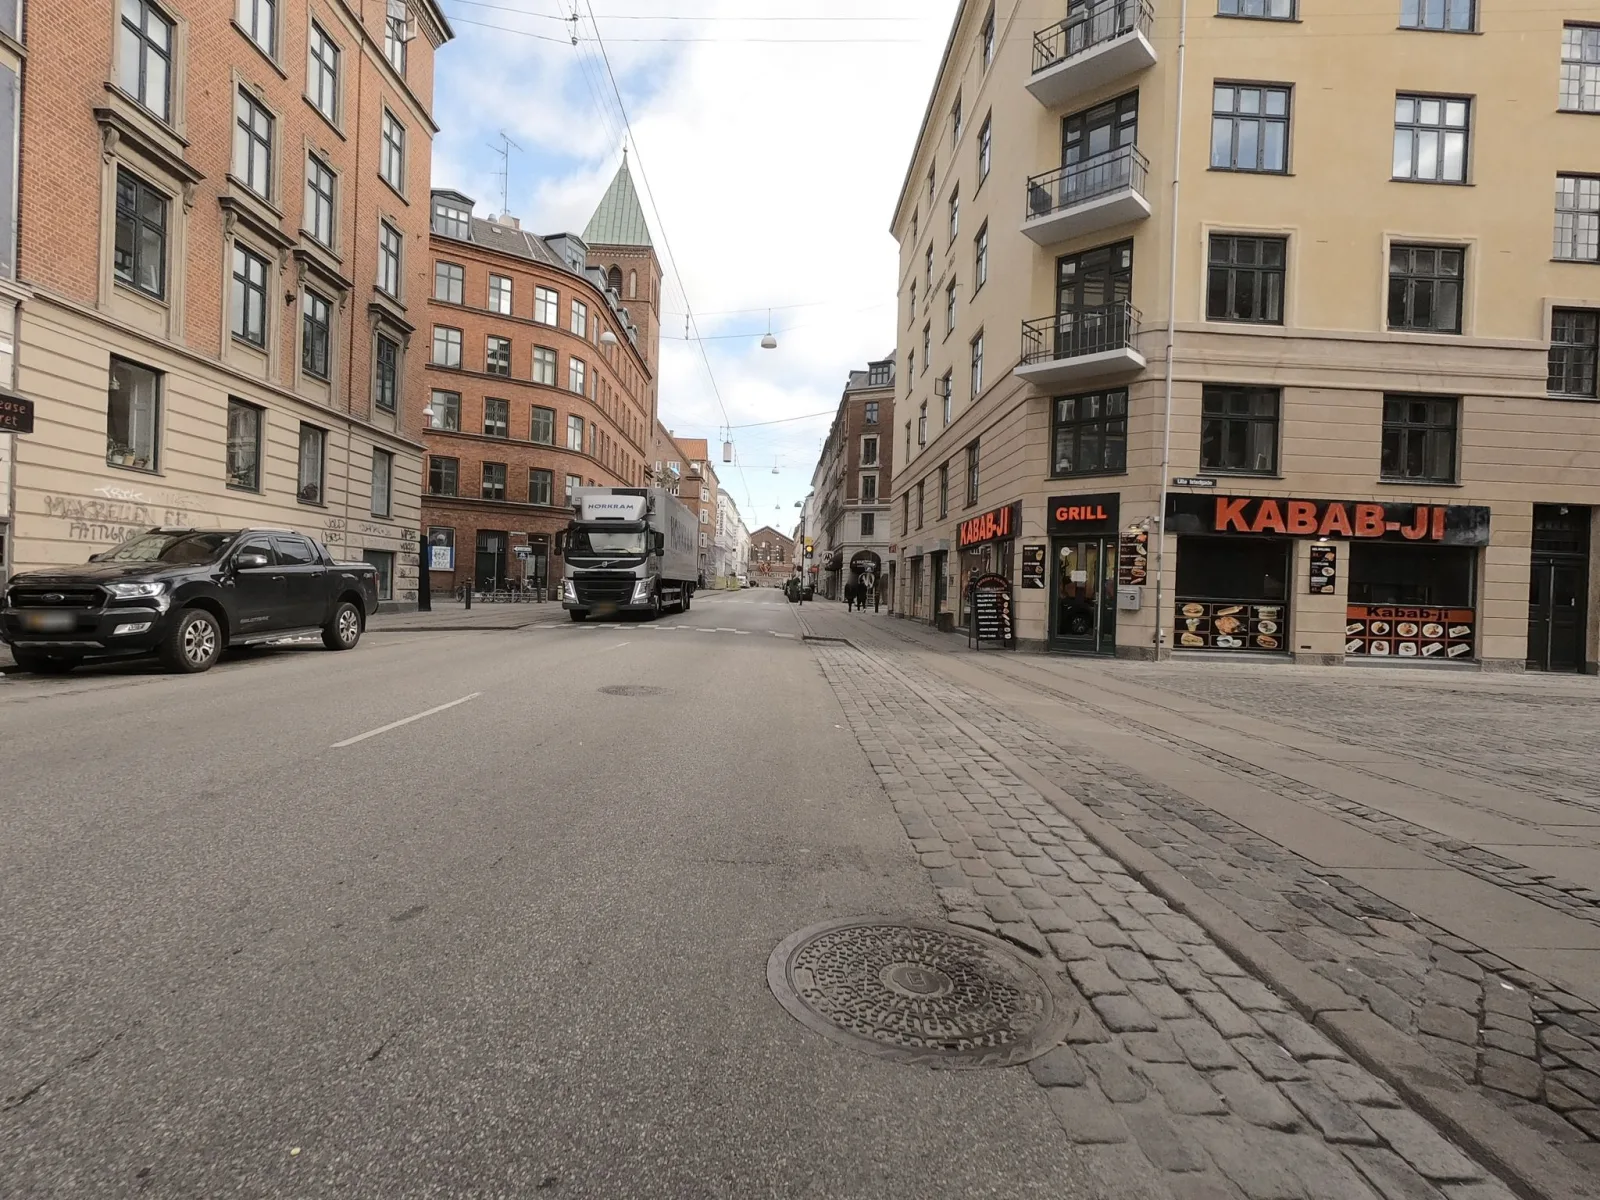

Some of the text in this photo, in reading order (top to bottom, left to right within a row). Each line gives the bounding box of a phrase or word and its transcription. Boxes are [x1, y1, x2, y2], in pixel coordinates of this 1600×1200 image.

[959, 506, 1009, 545] KABAB-JI
[1056, 505, 1107, 521] GRILL
[1214, 496, 1446, 541] KABAB-JI
[1366, 606, 1449, 621] Kabab-ji
